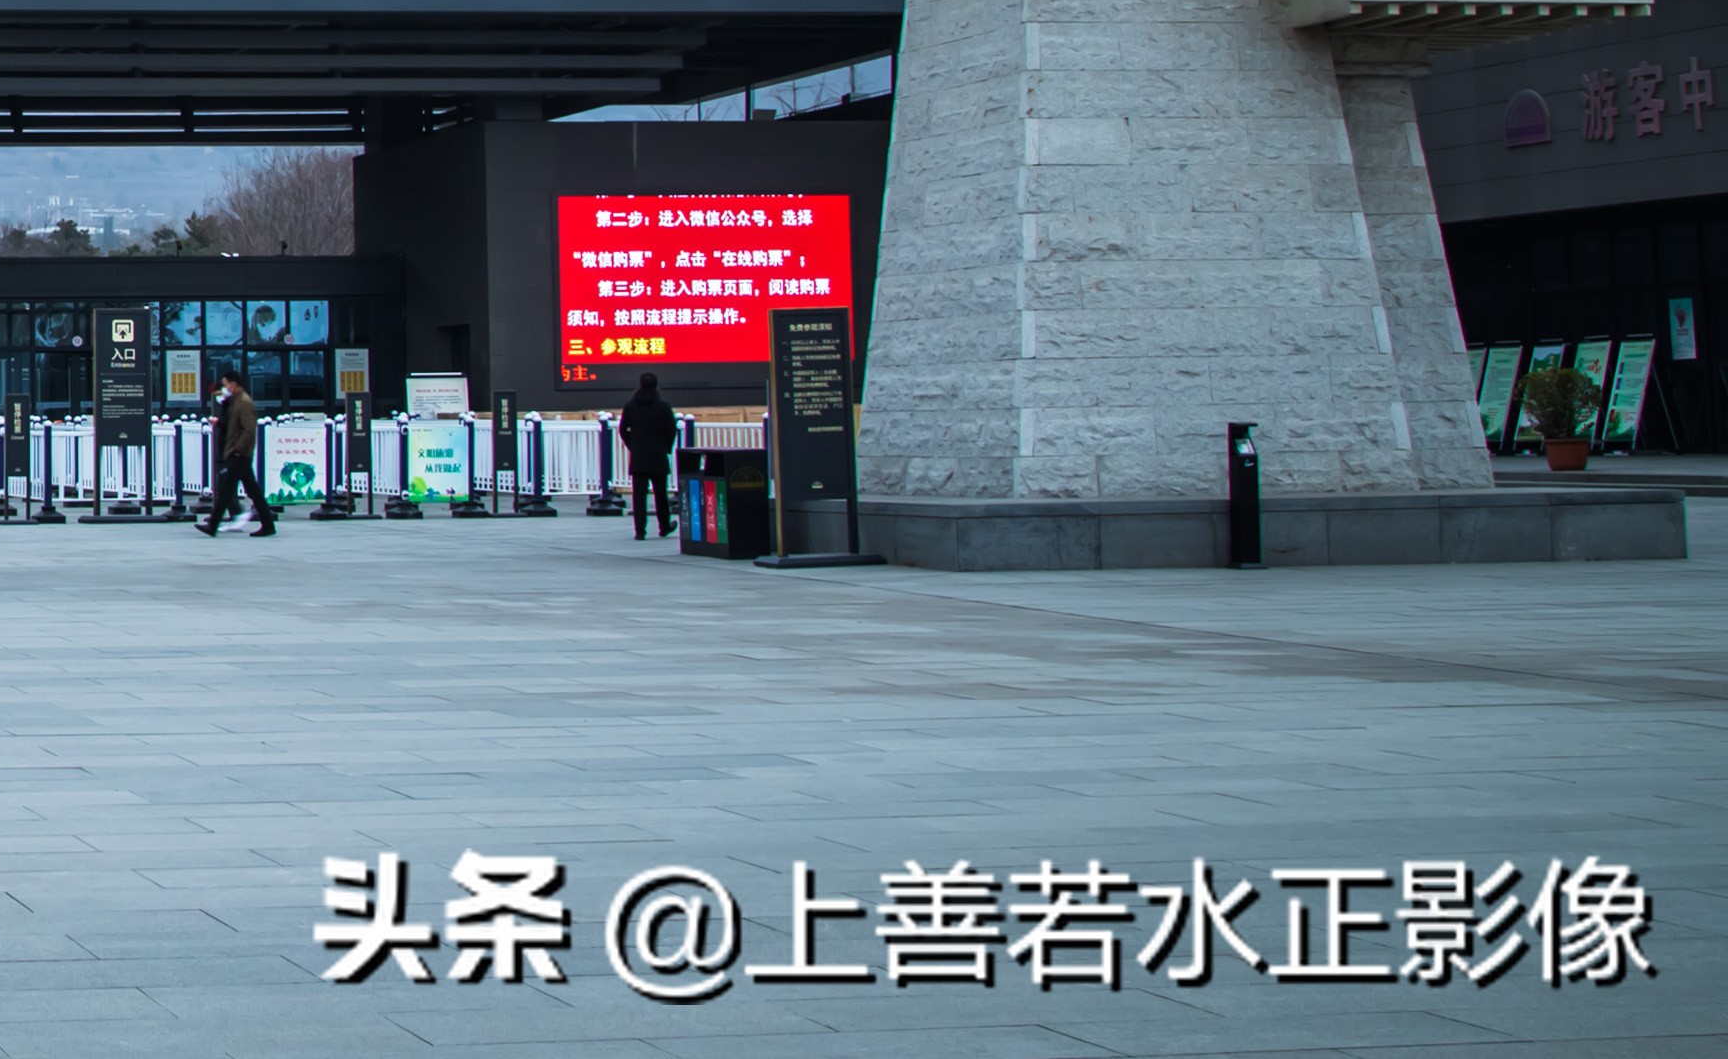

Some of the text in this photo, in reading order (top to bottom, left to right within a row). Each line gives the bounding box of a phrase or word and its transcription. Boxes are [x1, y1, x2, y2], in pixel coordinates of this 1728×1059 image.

[1580, 56, 1714, 141] 游客中
[111, 348, 136, 360] 入口
[568, 338, 666, 355] 三、参观流程
